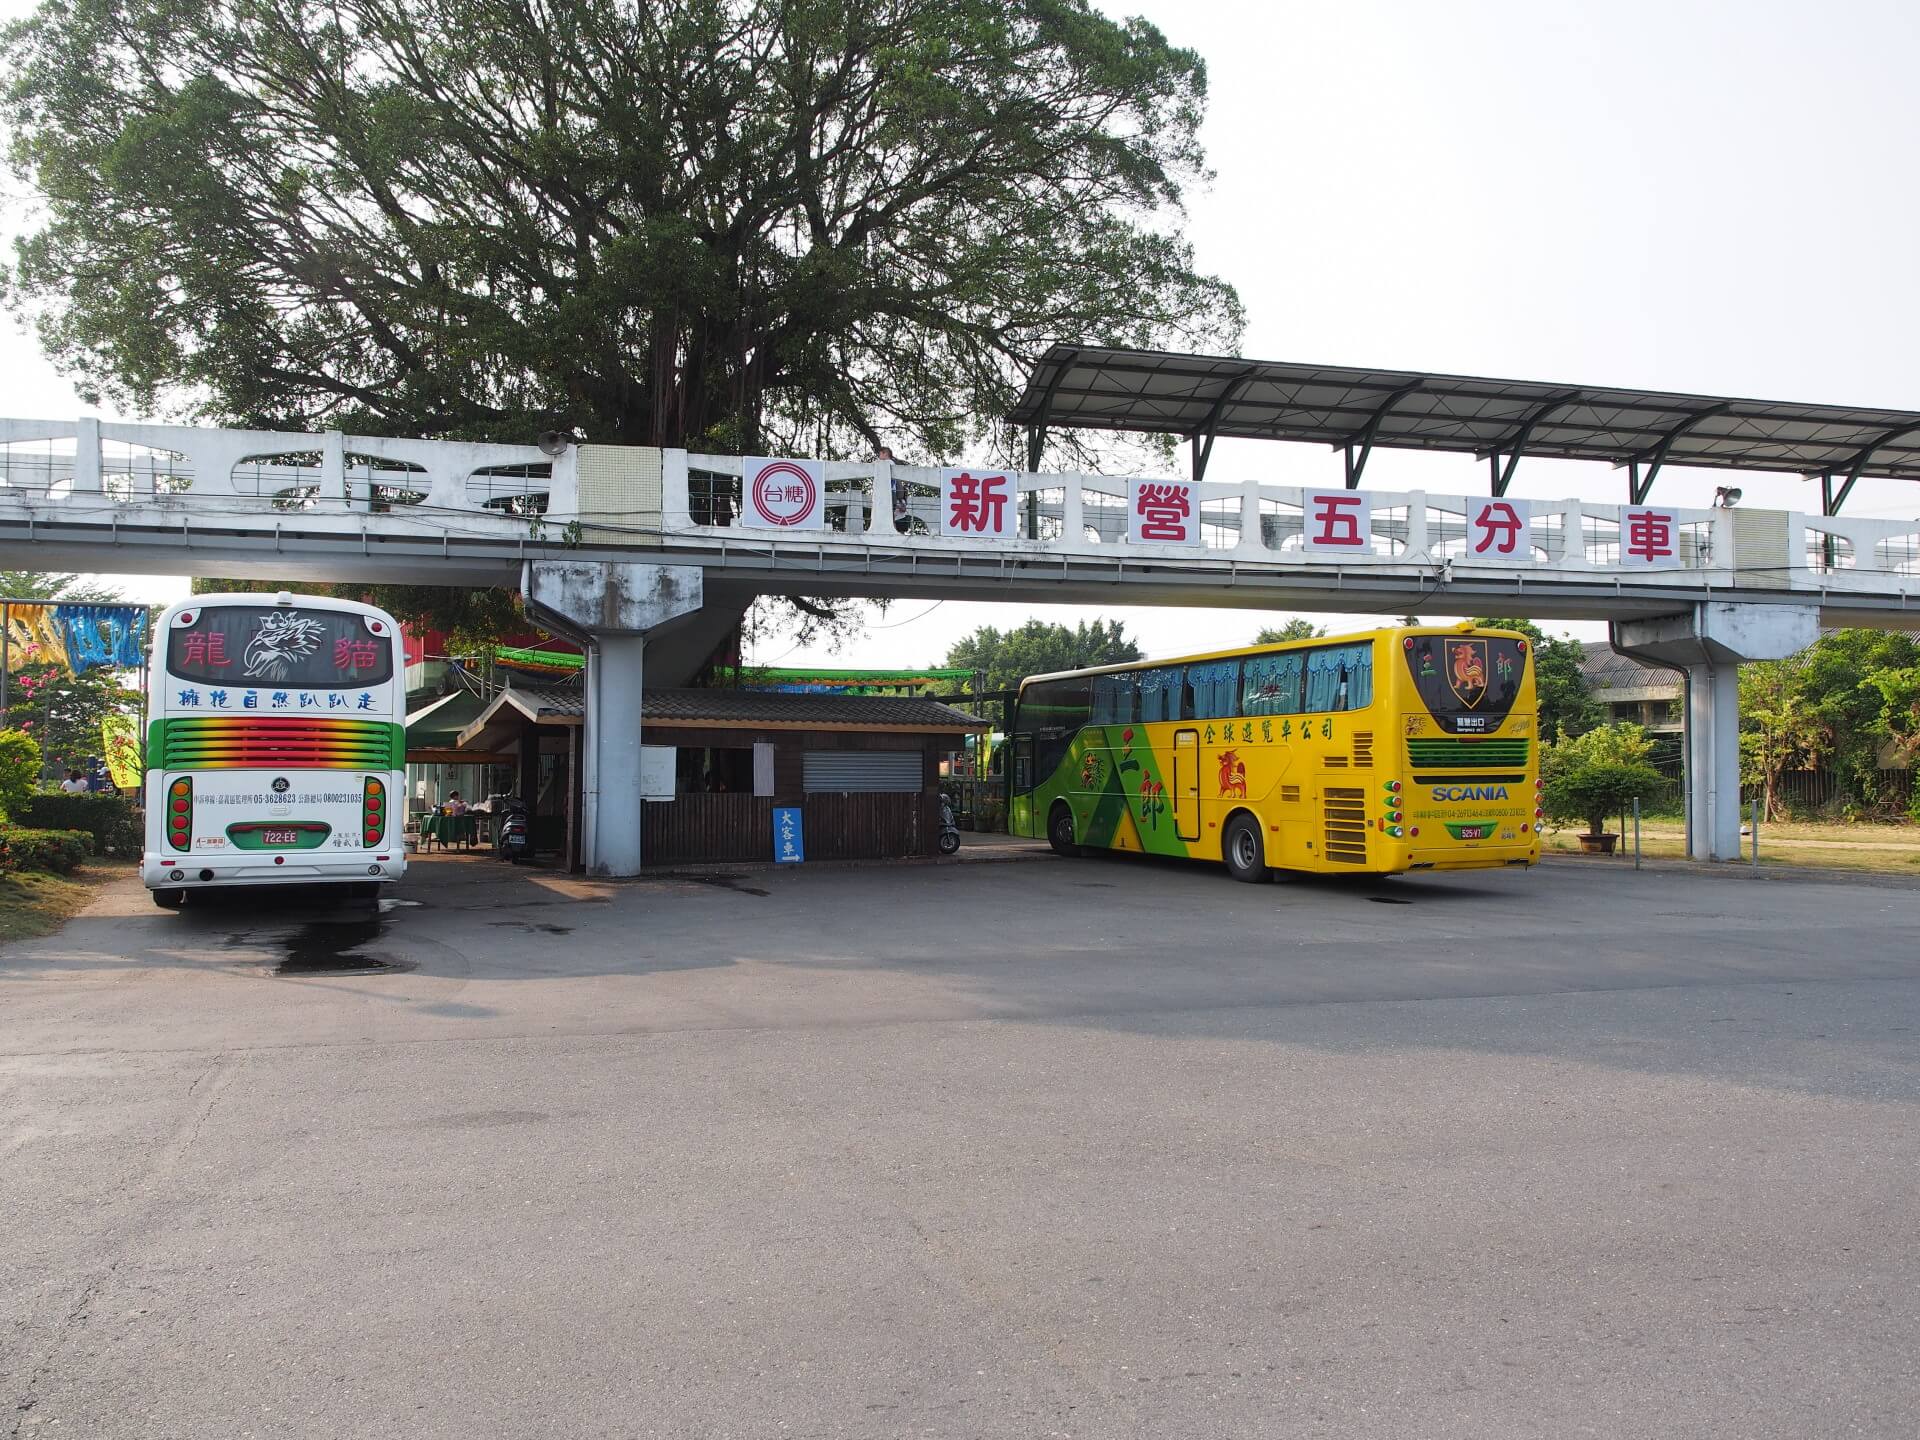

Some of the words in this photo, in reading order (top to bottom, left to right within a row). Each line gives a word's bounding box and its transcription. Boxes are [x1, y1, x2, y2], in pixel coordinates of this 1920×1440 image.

[764, 484, 804, 503] 台糖
[949, 472, 1673, 562] 新營五分車
[182, 631, 231, 666] 龍
[334, 637, 379, 669] 貓
[177, 688, 379, 711] 擁抱自然趴趴走
[1204, 718, 1333, 744] 全球遊覽車公司
[1431, 786, 1509, 801] SCANIA
[264, 832, 297, 844] 722-EE
[781, 811, 795, 856] 大客車
